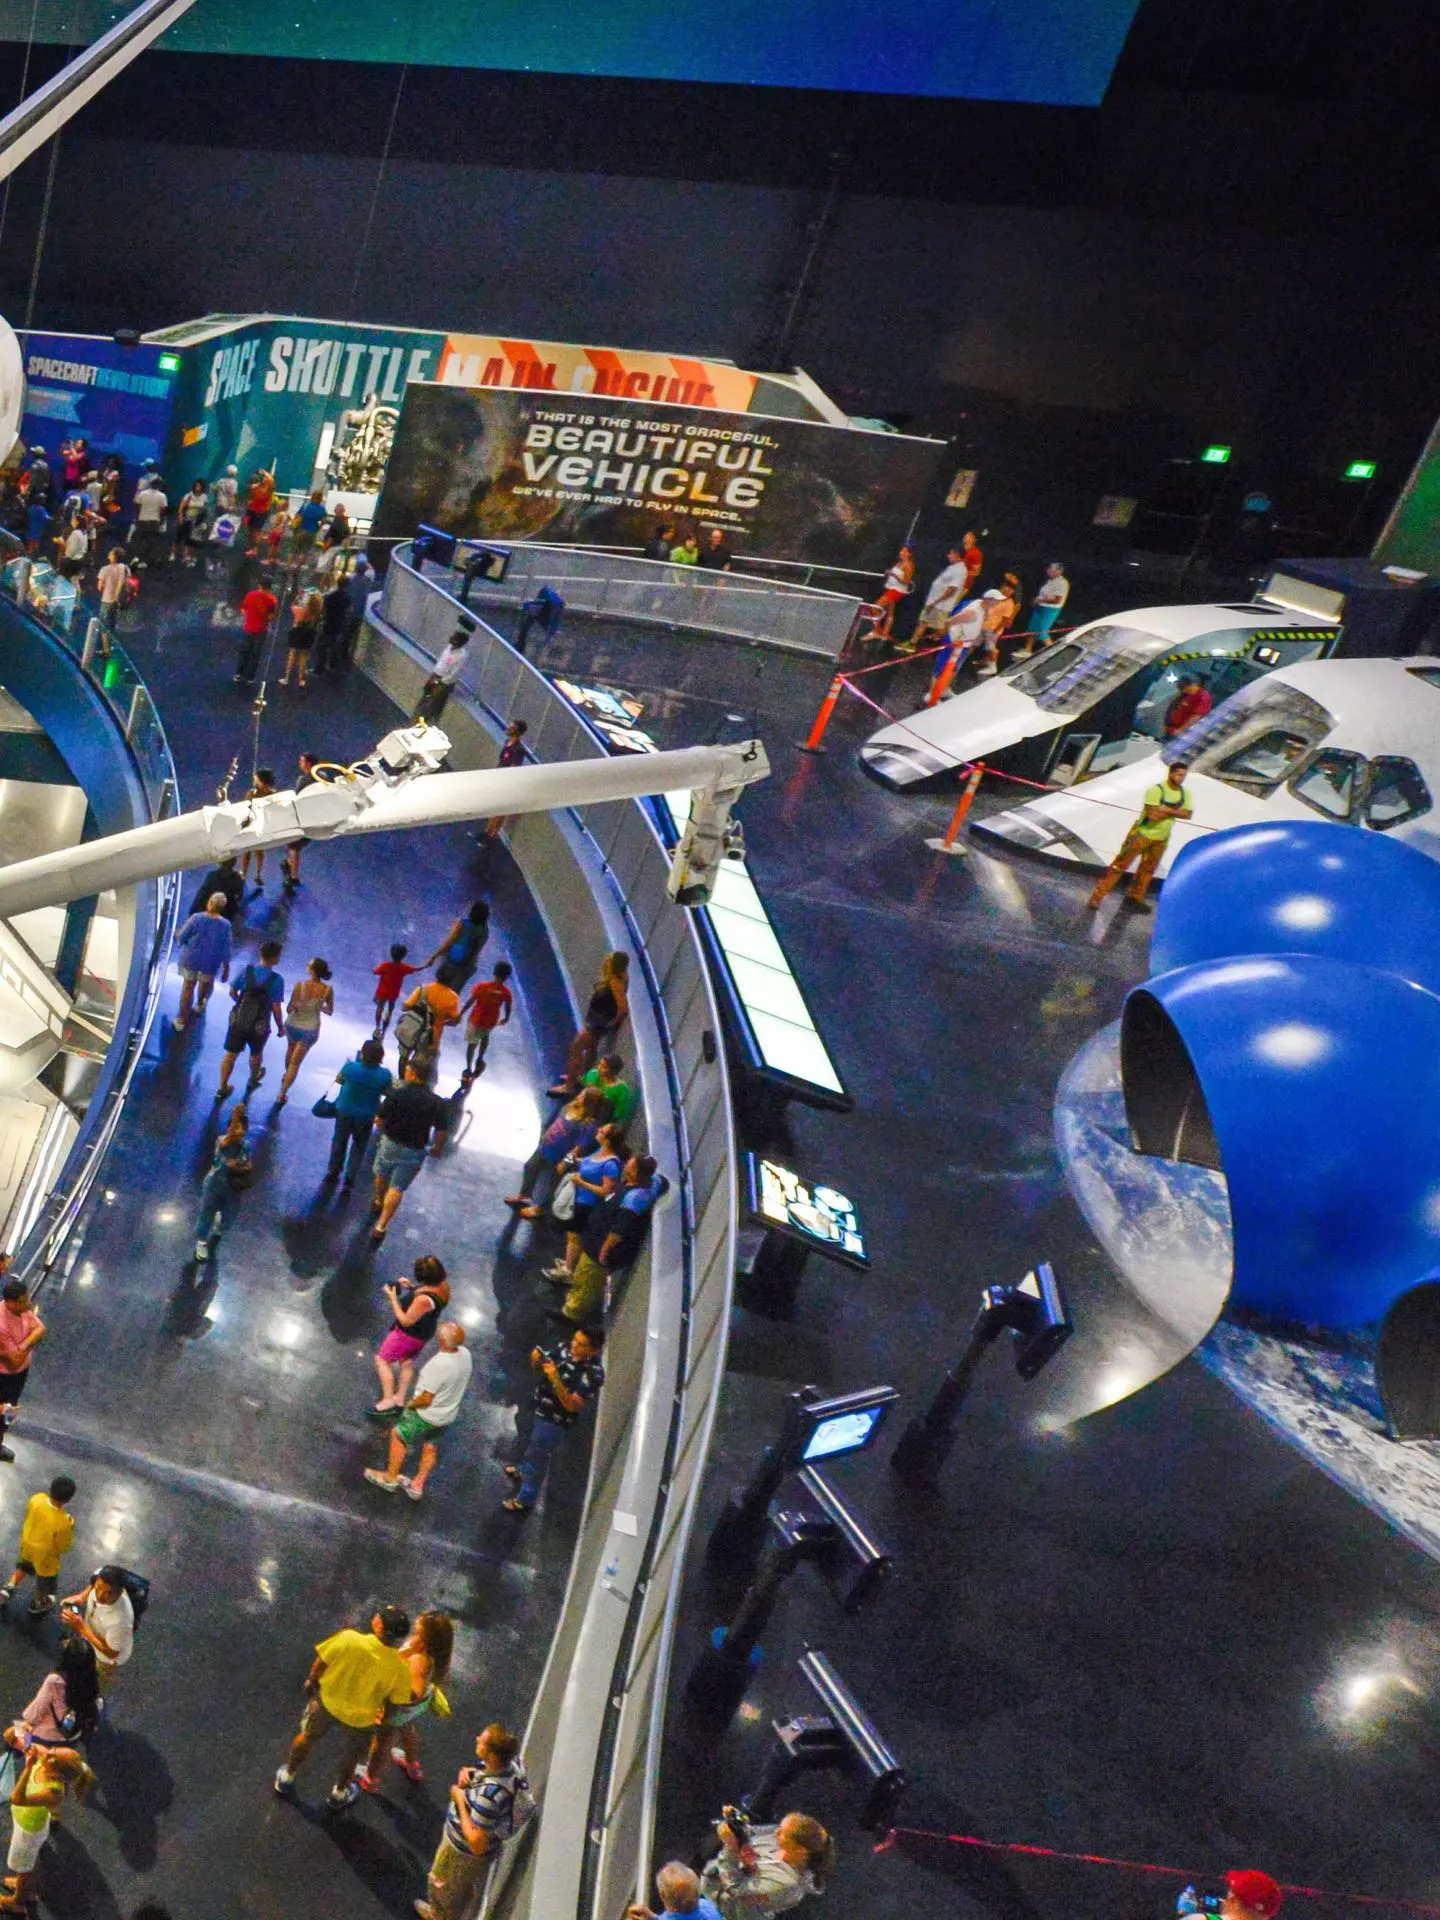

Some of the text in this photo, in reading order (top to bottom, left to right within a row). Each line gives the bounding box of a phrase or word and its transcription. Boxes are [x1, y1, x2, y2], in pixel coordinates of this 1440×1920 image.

[204, 338, 261, 407] SPACE
[264, 336, 432, 404] SHUTTLE
[443, 352, 556, 389] MAIN
[525, 423, 773, 475] BEAUTIFUL
[578, 413, 595, 426] IS
[599, 416, 631, 429] THE
[634, 420, 682, 435] MOST
[684, 425, 780, 449] GRACEFUL,
[512, 486, 554, 499] WE'VE
[554, 490, 591, 502] EVER
[593, 493, 622, 506] HAD
[626, 497, 643, 508] TO
[646, 500, 673, 512] FLY
[674, 504, 689, 515] IN
[522, 451, 766, 508] VEHICLE
